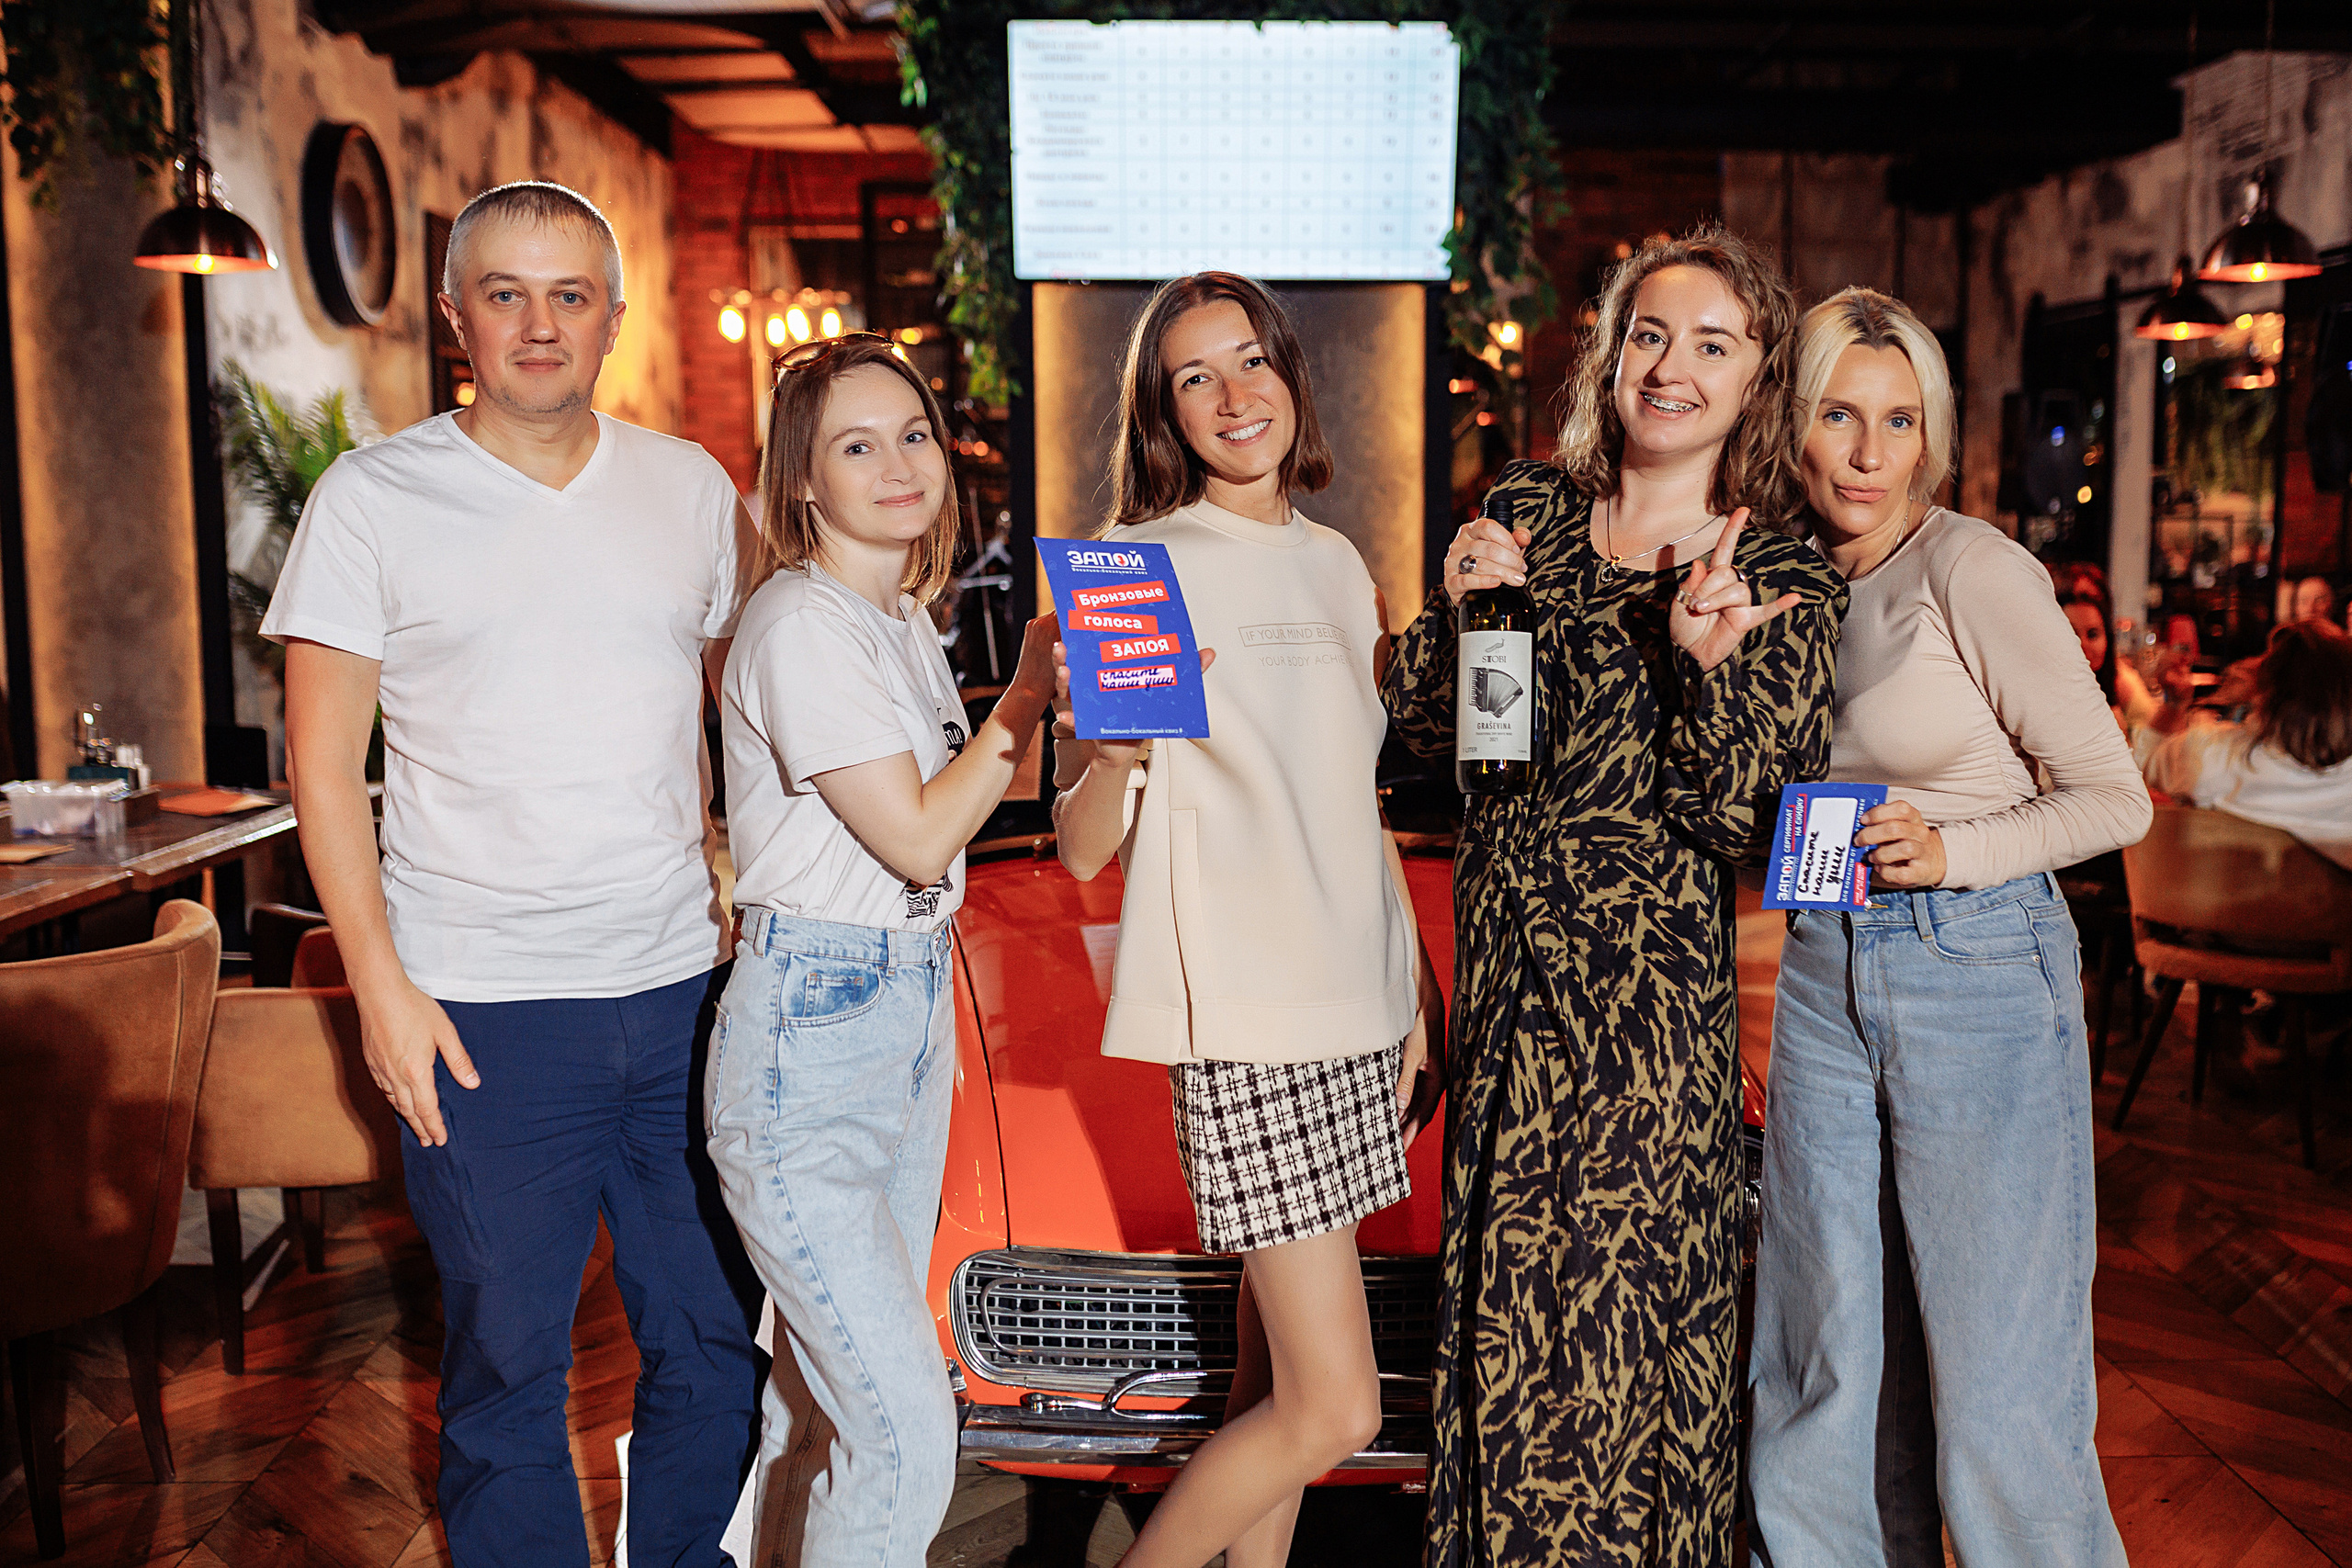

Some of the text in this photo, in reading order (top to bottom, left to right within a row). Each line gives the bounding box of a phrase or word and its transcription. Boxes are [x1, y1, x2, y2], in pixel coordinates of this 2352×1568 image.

[1067, 549, 1146, 568] ЗАПОЙ
[1078, 587, 1164, 607] Бронзовые
[1083, 615, 1143, 629] голоса
[1246, 630, 1255, 641] IF
[1257, 628, 1286, 639] YOUR
[1286, 628, 1313, 639] MIND
[1111, 638, 1170, 658] ЗАПОЯ
[1259, 656, 1286, 667] YOUR
[1287, 656, 1310, 667] BODY
[1481, 655, 1507, 663] STOBI
[1476, 721, 1511, 730] GRAŠEVINA
[1794, 797, 1804, 837] НА СКИДКУ
[1784, 809, 1793, 853] СЕРТИФИКАТ
[1798, 830, 1820, 894] Спасите
[1826, 846, 1846, 885] уши
[1777, 855, 1794, 901] ЗАПОЙ
[1813, 850, 1829, 896] наши
[1845, 860, 1855, 888] КОМАНДЫ
